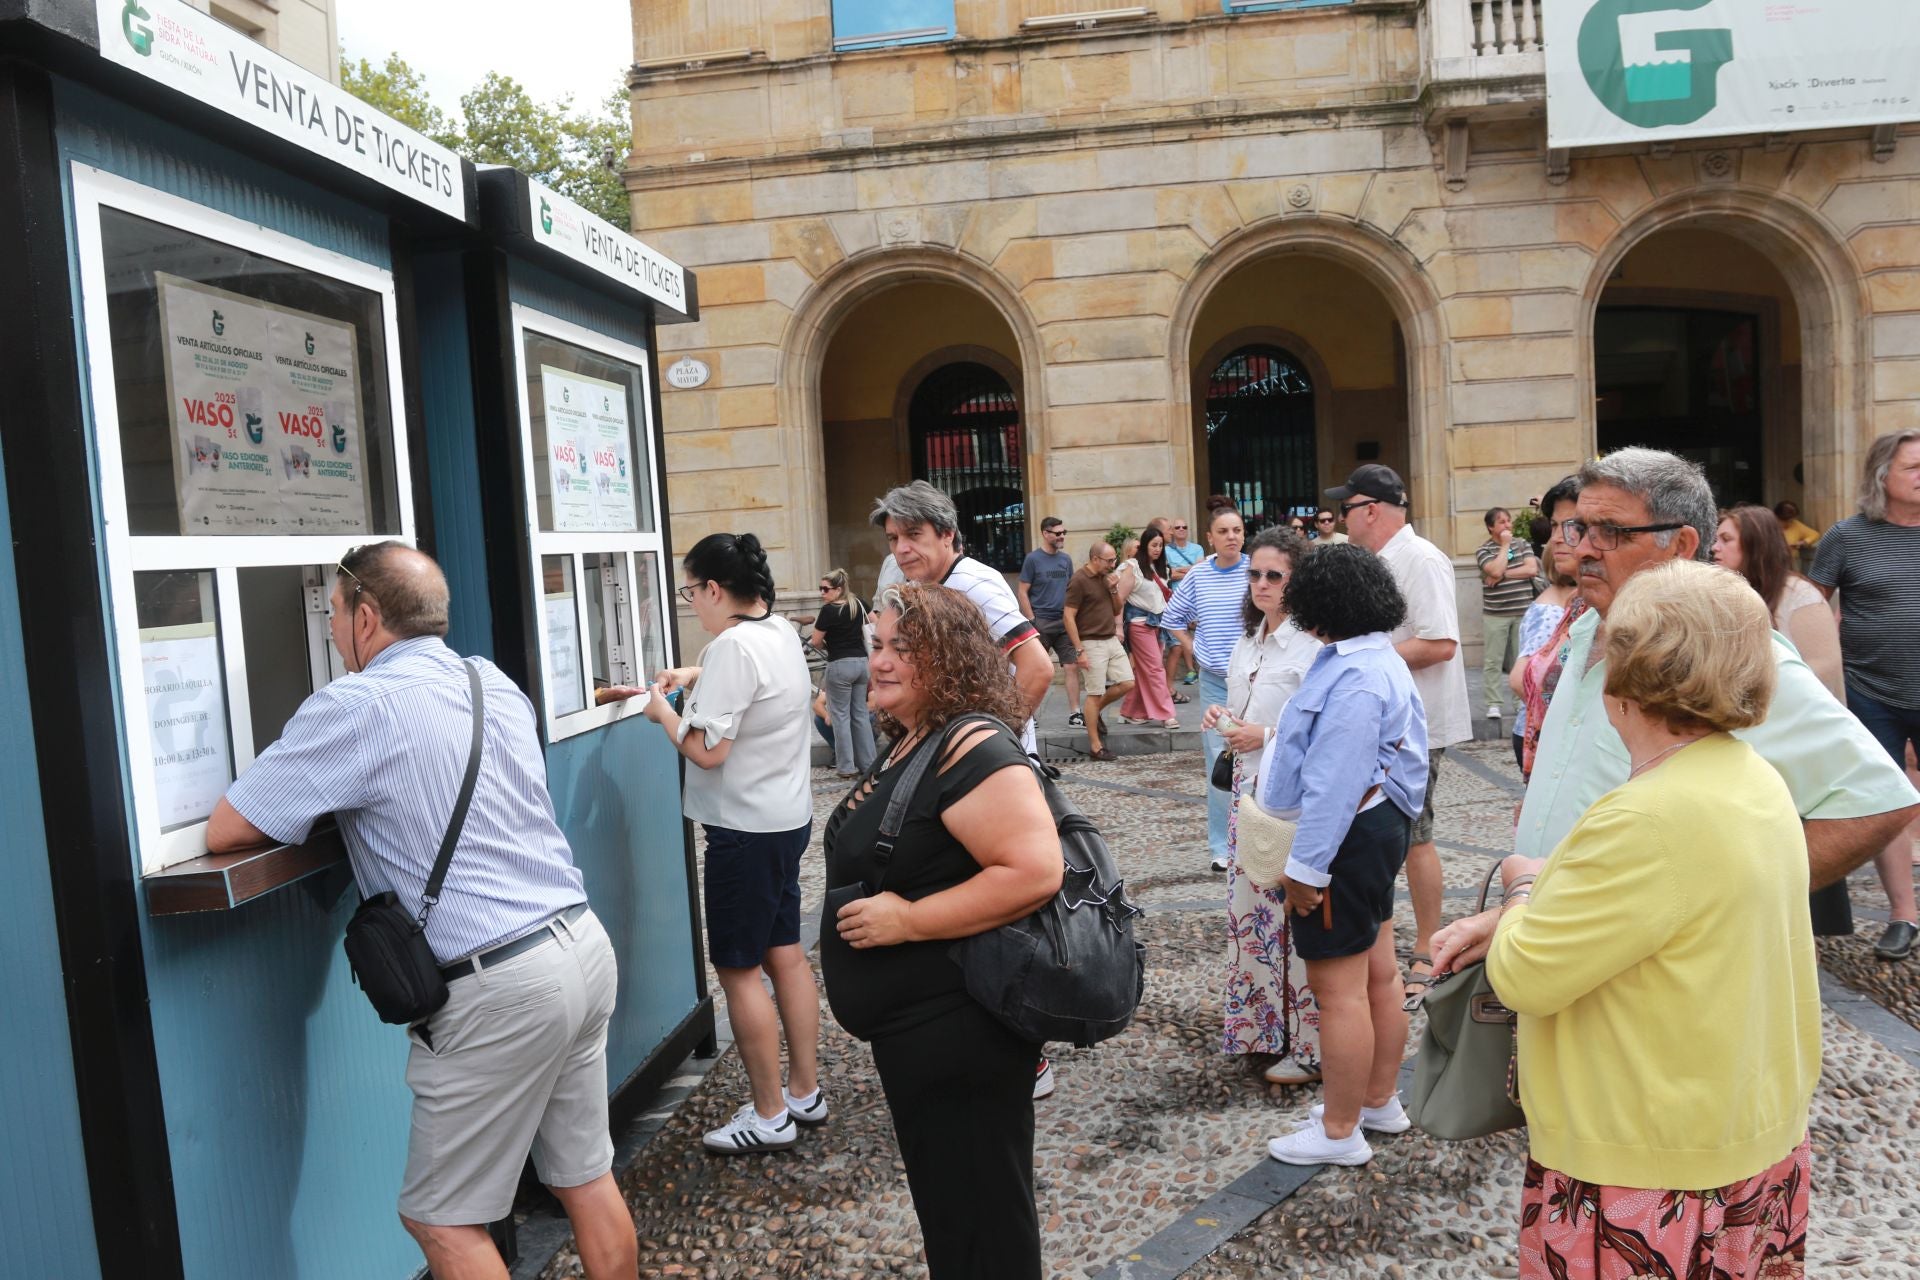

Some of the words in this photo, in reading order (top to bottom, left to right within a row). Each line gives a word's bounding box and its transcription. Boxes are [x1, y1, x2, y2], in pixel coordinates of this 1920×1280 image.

[157, 14, 180, 33] FIESTA
[183, 27, 193, 41] DE
[195, 34, 205, 46] LA
[158, 28, 181, 48] SIDRA
[183, 41, 218, 66] NATURAL
[229, 50, 328, 137] VENTA
[334, 105, 366, 155] DE
[372, 125, 453, 198] TICKETS
[581, 221, 623, 268] VENTA
[626, 247, 640, 277] DE
[642, 256, 681, 298] TICKETS
[177, 336, 199, 349] VENTA
[233, 347, 263, 361] OFICIALES
[275, 355, 293, 367] VENTA
[320, 365, 348, 378] OFICIALES
[675, 367, 699, 375] PLAZA
[677, 376, 699, 384] MAYOR
[214, 392, 236, 404] 2025
[183, 397, 234, 428] VASO
[308, 406, 324, 417] 2025
[278, 411, 323, 438] VASO
[227, 428, 238, 439] 5€
[221, 452, 240, 460] VASO
[240, 453, 269, 463] EDICIONES
[553, 445, 576, 463] VASO
[594, 450, 615, 468] VASO
[228, 462, 265, 472] ANTERIORES
[144, 683, 181, 695] HORARIO
[181, 679, 213, 690] TAQUILLA
[154, 716, 190, 729] DOMINGO
[154, 755, 176, 767] 10:00
